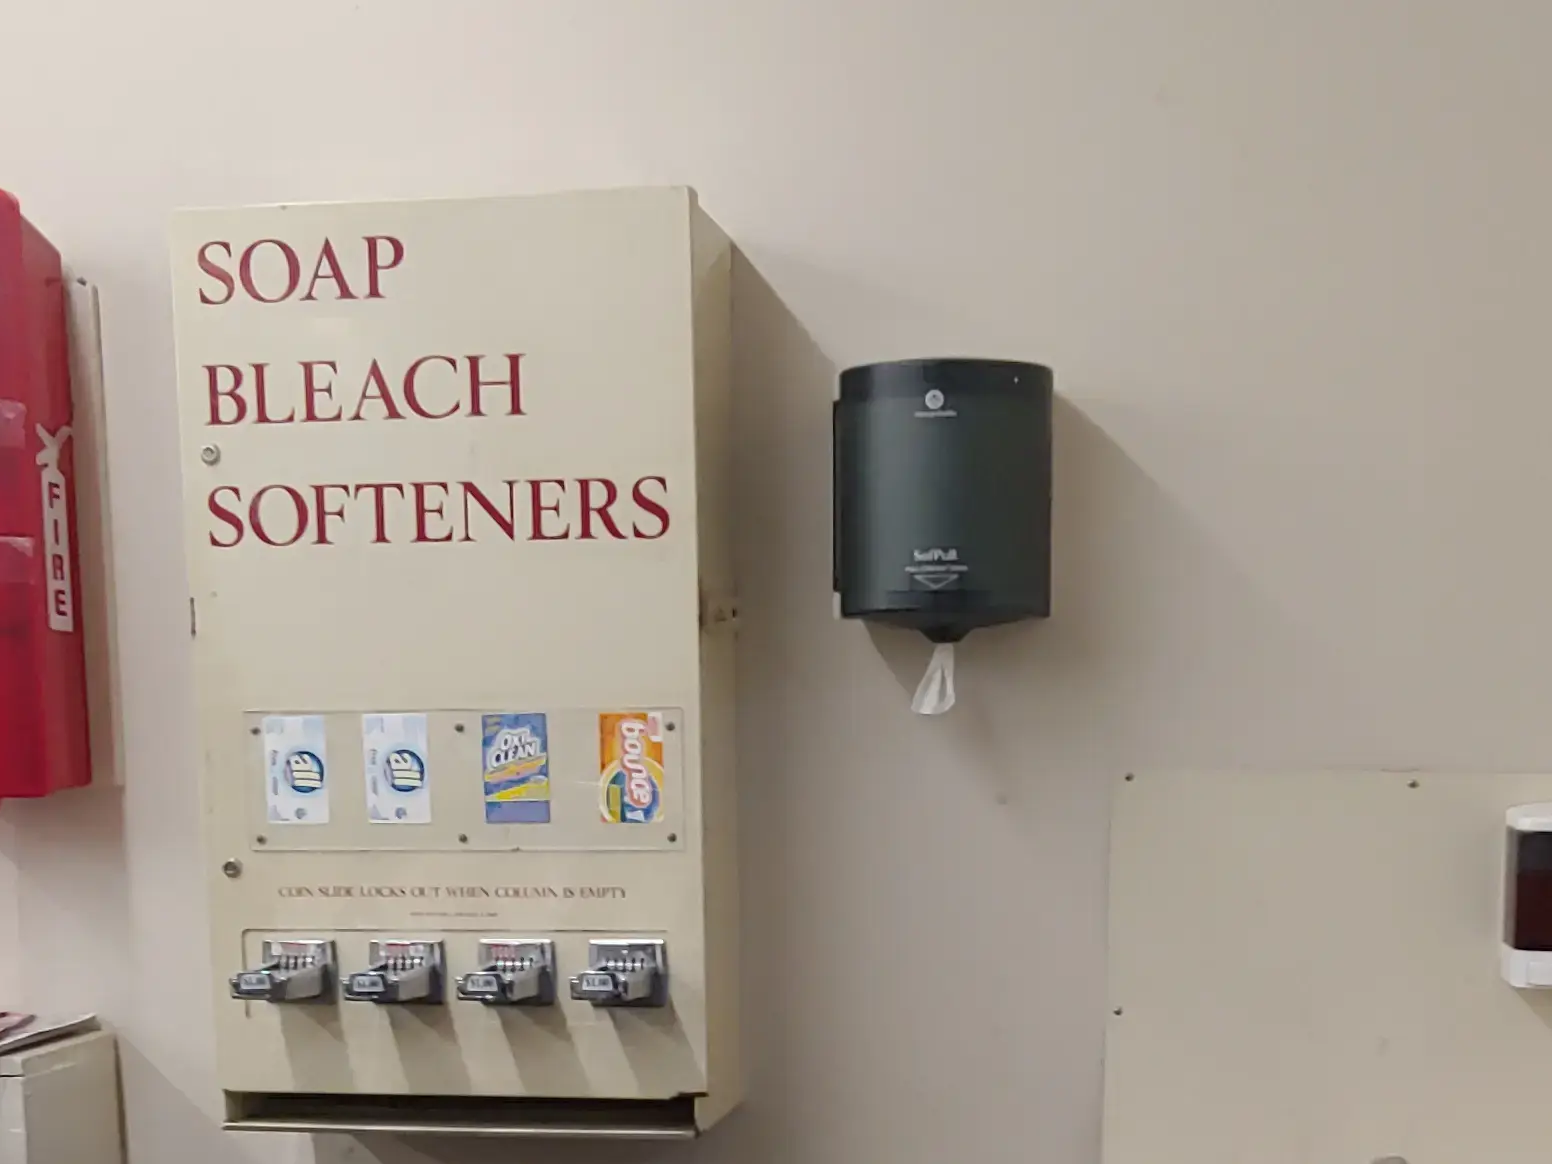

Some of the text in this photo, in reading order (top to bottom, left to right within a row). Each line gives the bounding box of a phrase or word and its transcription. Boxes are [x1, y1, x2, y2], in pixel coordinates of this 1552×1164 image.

[197, 234, 405, 306] SOAP
[202, 352, 528, 427] BLEACH
[48, 481, 68, 617] FIRE
[207, 475, 671, 549] SOFTENERS
